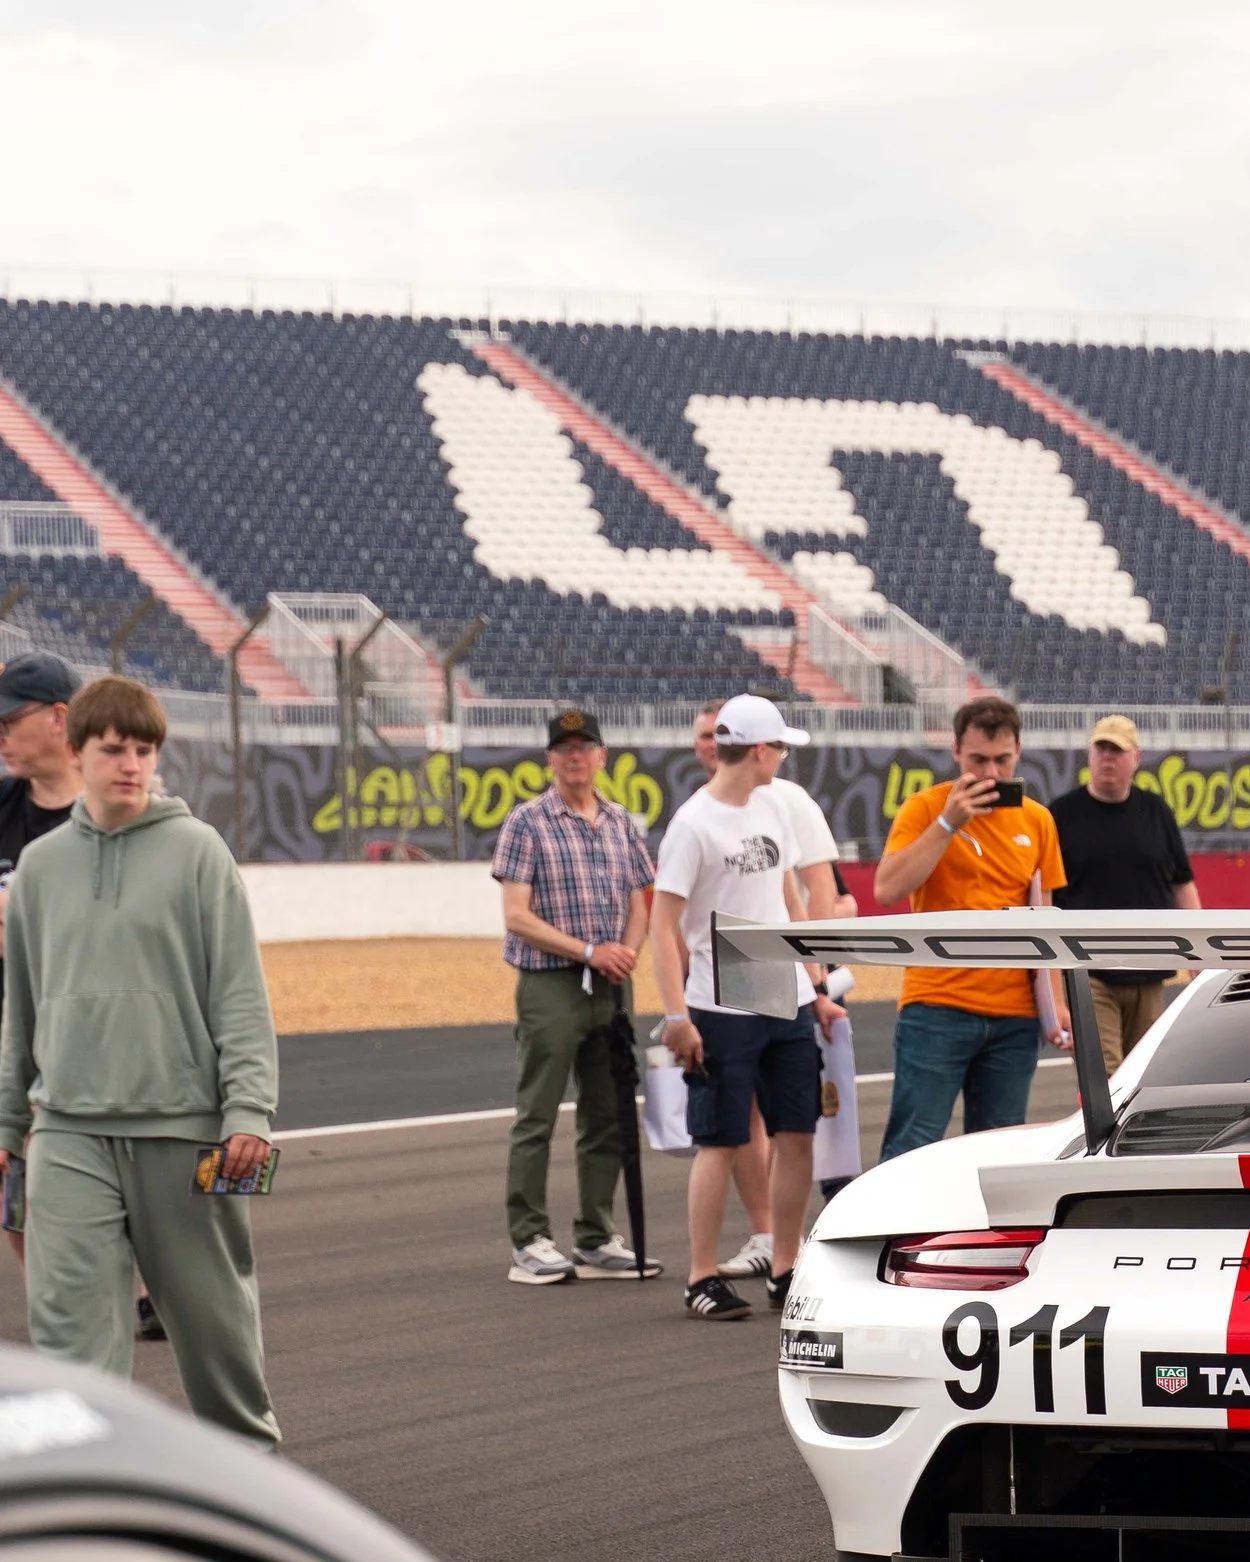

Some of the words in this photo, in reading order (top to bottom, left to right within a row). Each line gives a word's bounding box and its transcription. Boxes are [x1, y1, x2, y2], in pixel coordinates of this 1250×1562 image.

[788, 1342, 836, 1358] MICHELIN
[942, 1300, 1111, 1415] 911
[1158, 1368, 1185, 1377] TAG
[1158, 1379, 1186, 1394] HEUER
